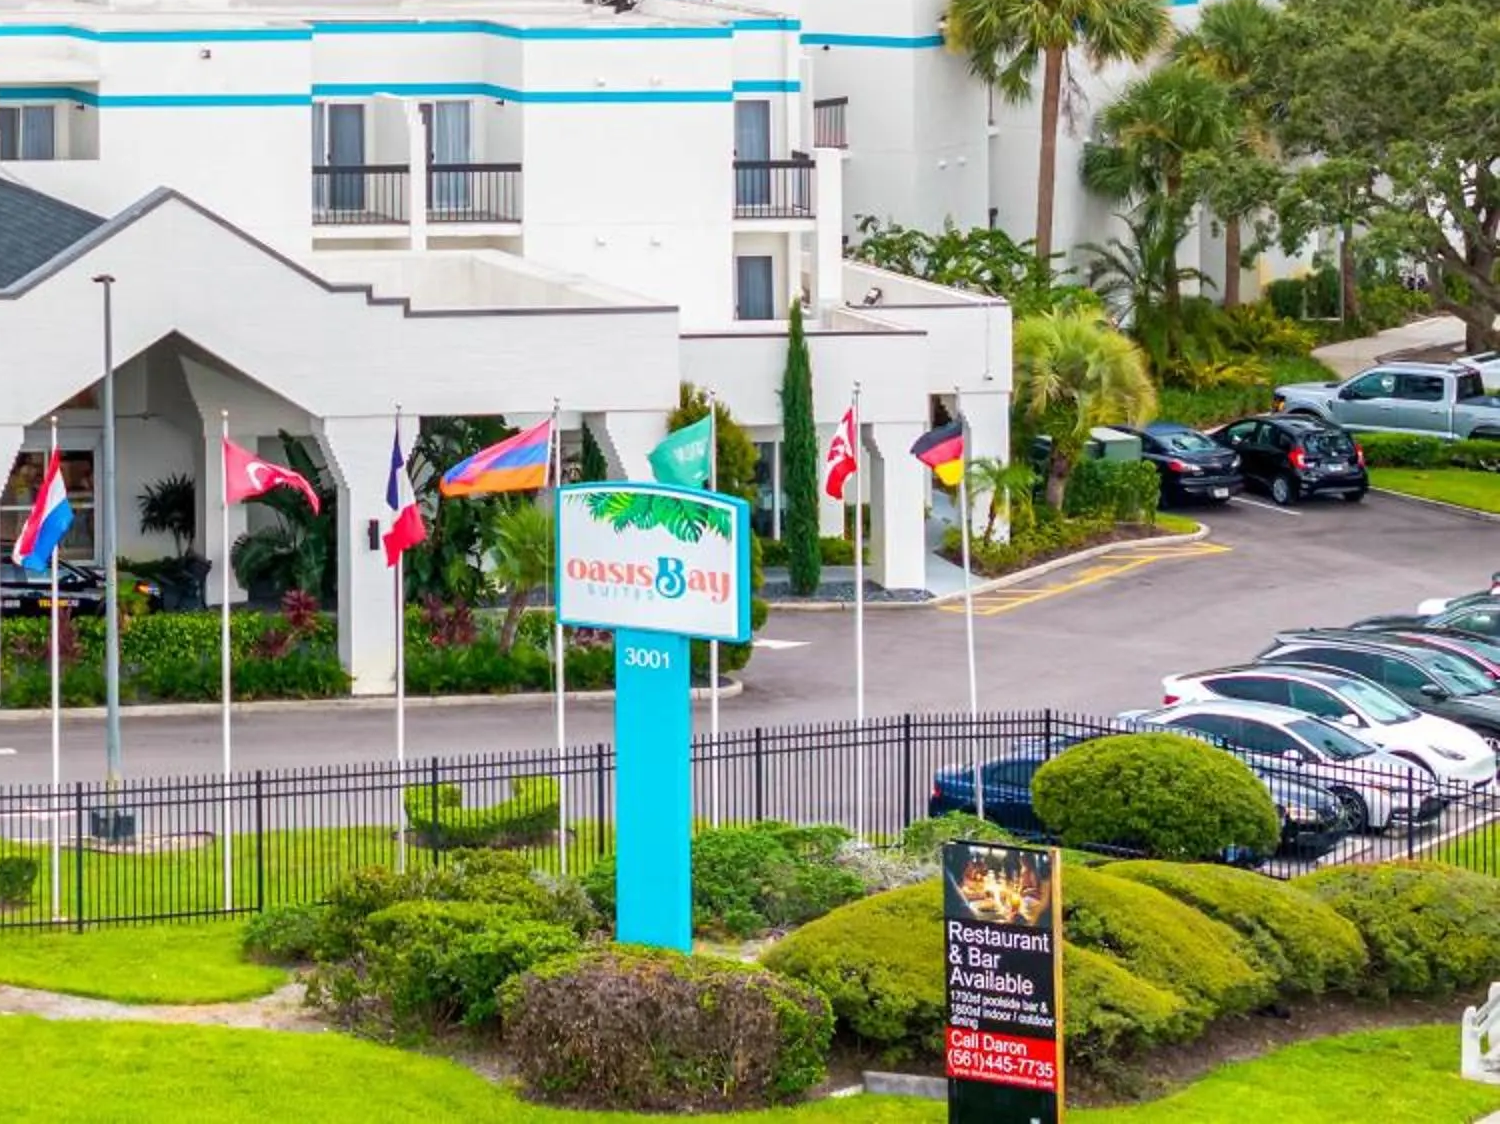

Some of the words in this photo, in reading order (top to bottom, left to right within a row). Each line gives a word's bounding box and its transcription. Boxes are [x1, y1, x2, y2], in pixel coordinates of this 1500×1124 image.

[655, 556, 731, 604] Bay
[624, 647, 670, 669] 3001
[947, 920, 1050, 953] Restaurant
[948, 943, 963, 965] &
[967, 945, 1001, 969] Bar
[949, 965, 1034, 996] Available
[951, 1029, 979, 1049] Call
[983, 1034, 1028, 1056] Daron
[947, 1048, 1055, 1079] (561)445-7735
